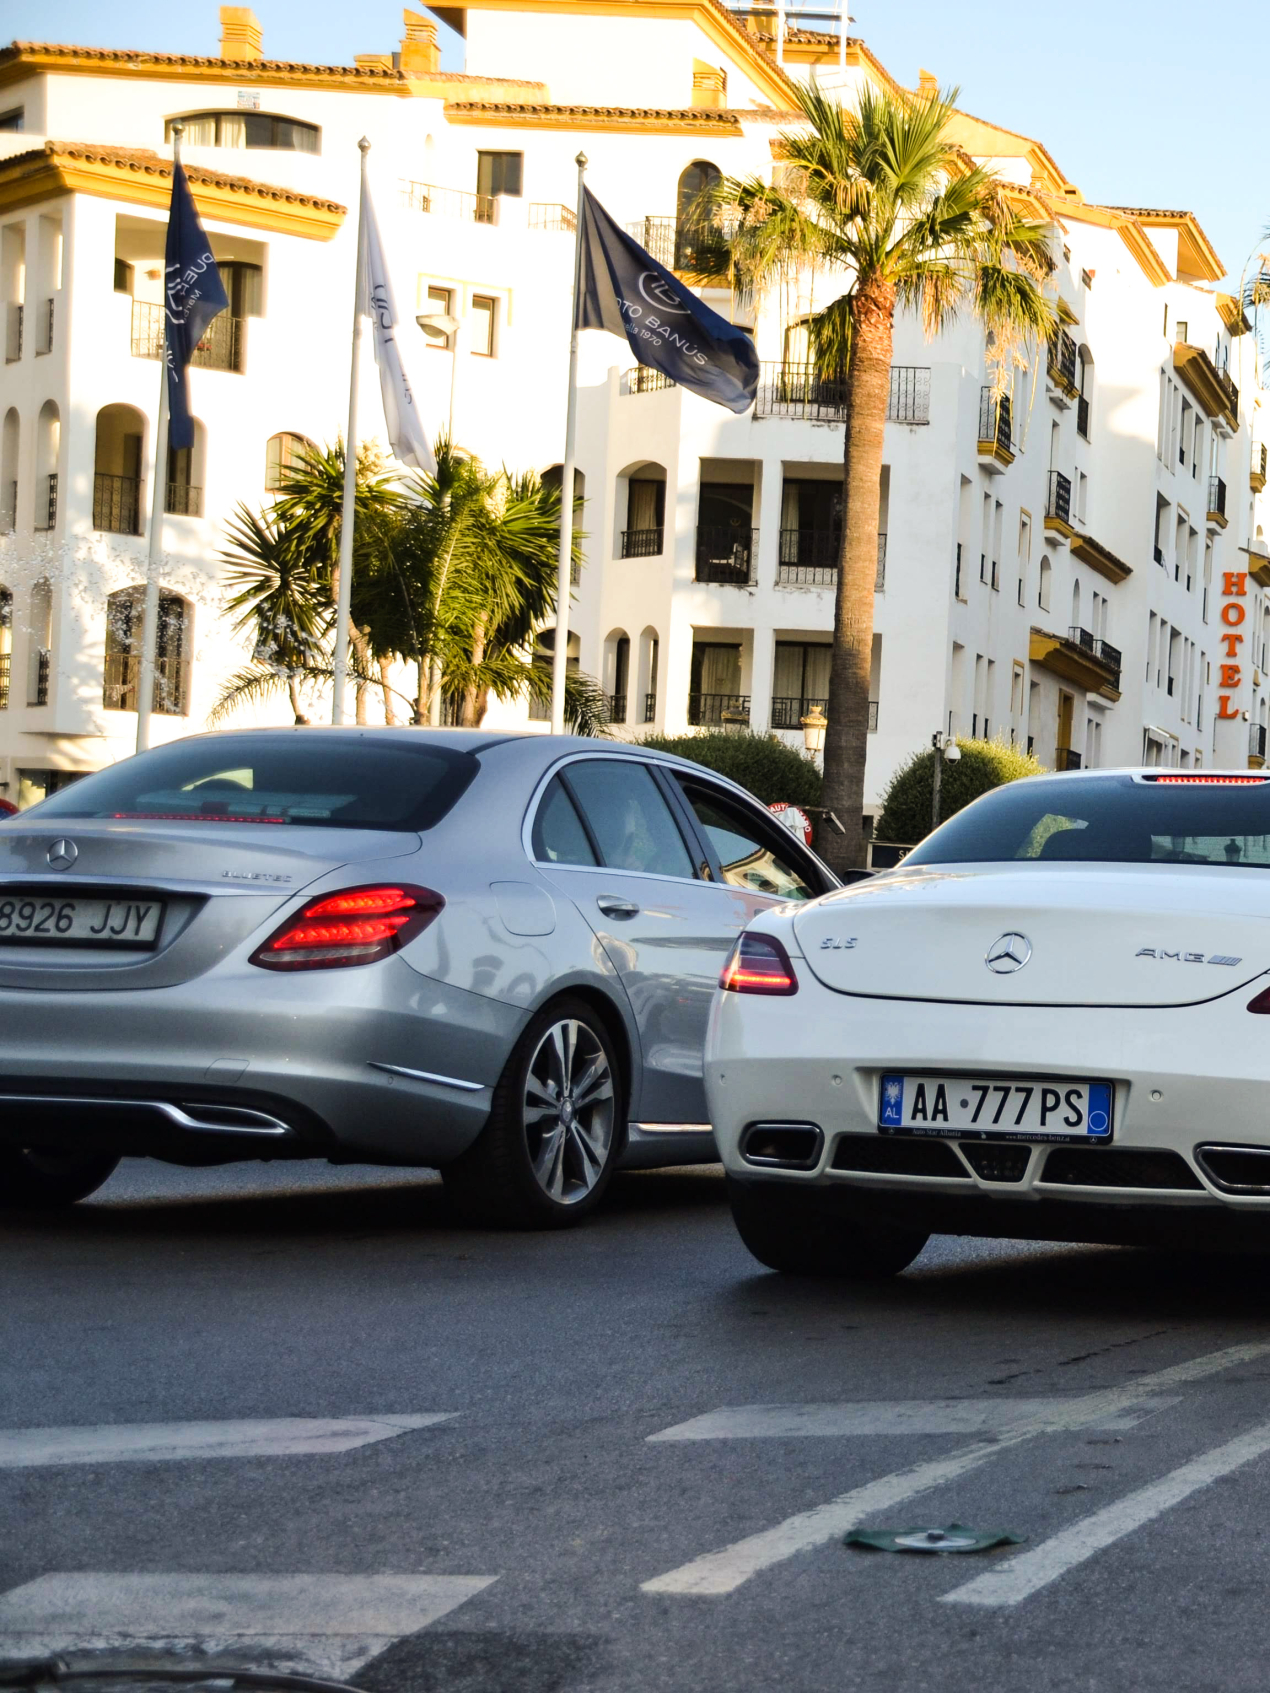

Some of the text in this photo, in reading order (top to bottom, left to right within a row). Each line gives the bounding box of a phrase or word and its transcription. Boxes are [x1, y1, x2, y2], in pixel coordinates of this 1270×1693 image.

[640, 329, 662, 346] 1970
[645, 315, 708, 365] BANÚS
[1218, 572, 1248, 719] HOTEL
[222, 870, 293, 882] BLUETEC
[0, 901, 153, 936] 8926 JJY
[820, 937, 1205, 963] SLS AMG
[885, 1107, 899, 1118] AL
